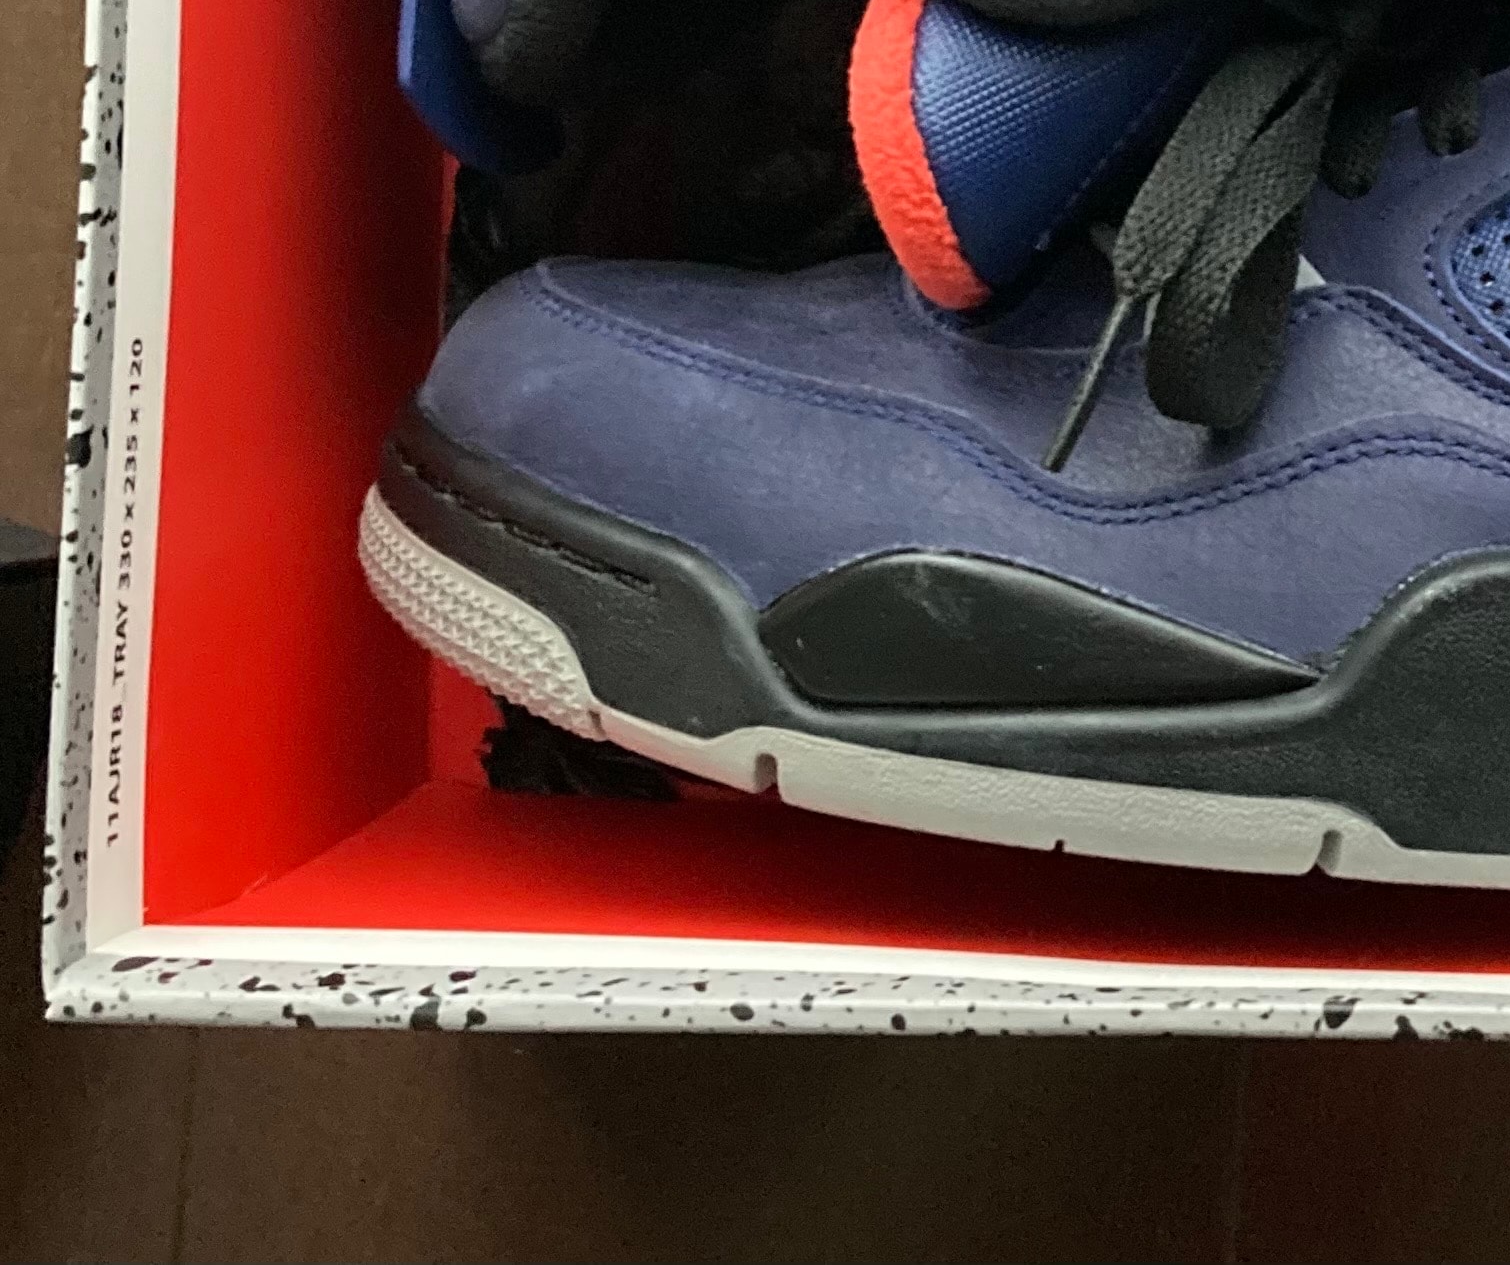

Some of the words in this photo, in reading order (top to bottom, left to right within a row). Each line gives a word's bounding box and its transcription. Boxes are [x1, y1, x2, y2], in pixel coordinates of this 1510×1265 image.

[130, 338, 143, 397] 120
[123, 434, 138, 495] 235
[118, 529, 132, 590] 330
